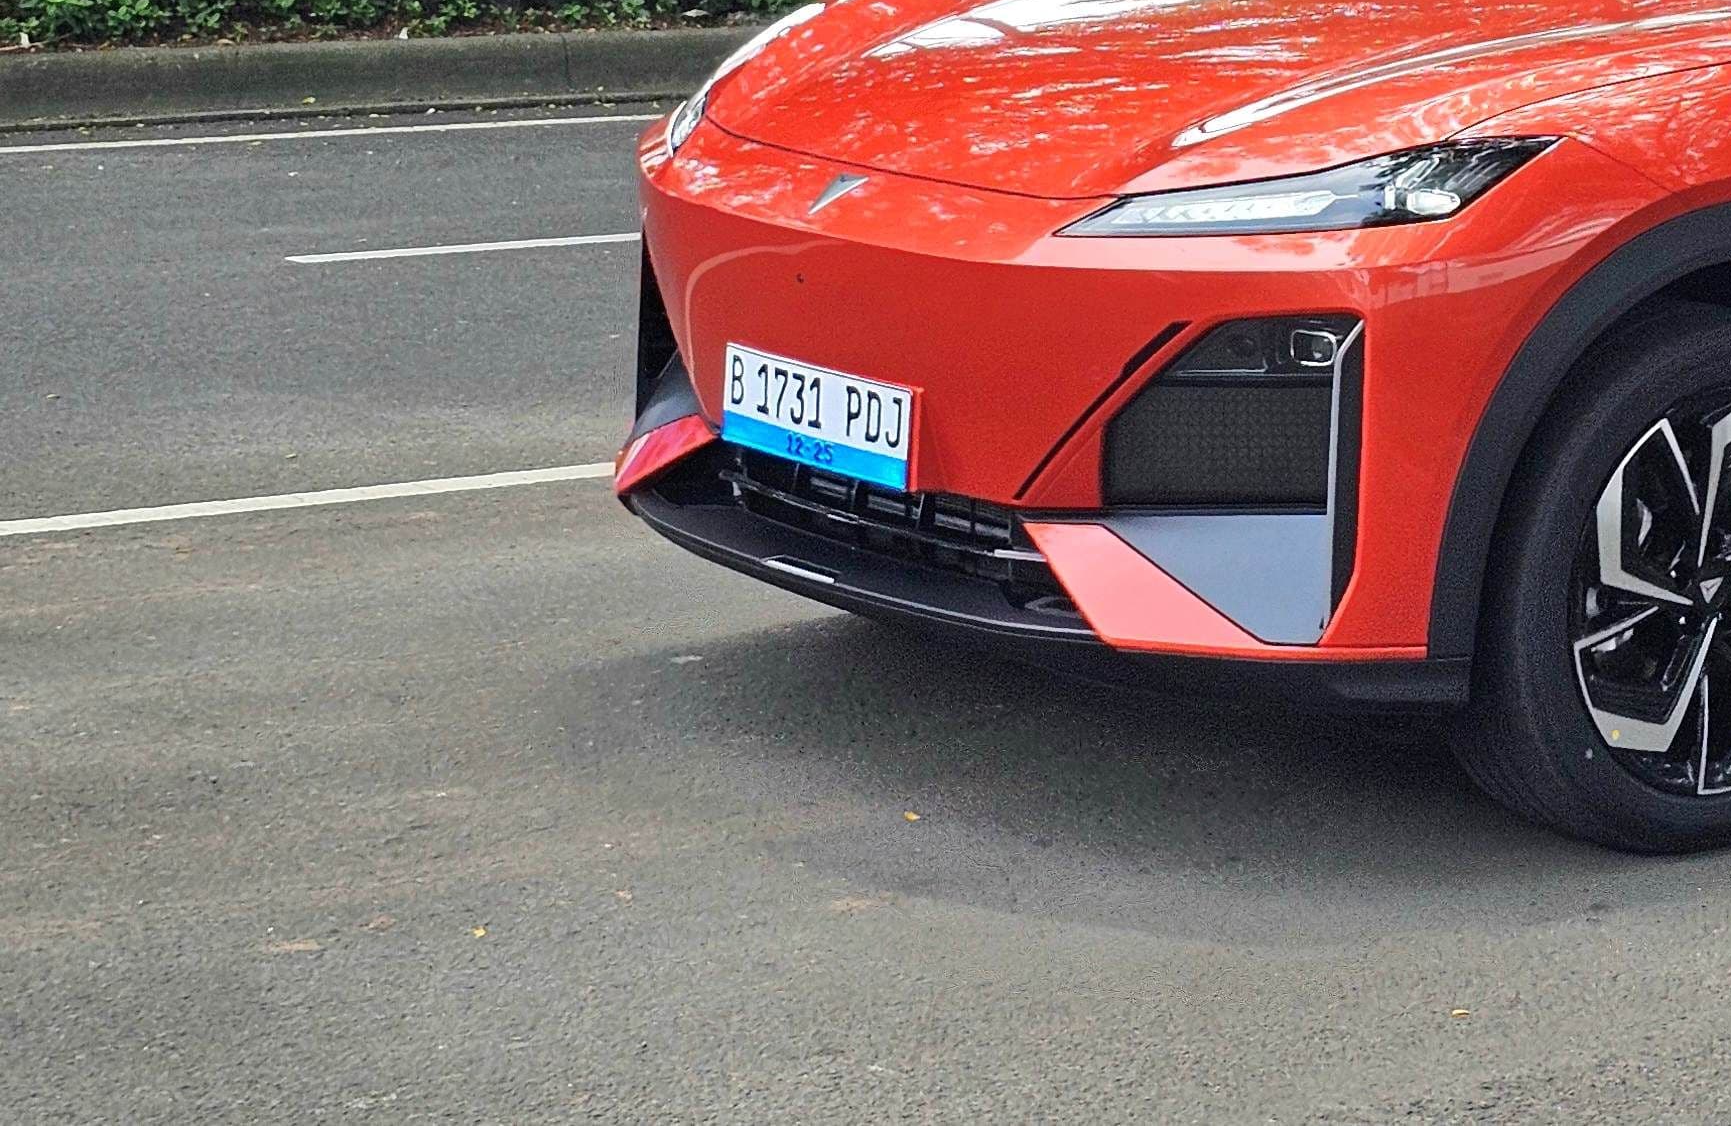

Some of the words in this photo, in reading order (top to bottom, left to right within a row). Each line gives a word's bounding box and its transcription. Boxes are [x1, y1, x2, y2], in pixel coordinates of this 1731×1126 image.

[731, 354, 745, 405] B
[757, 363, 822, 429] 1731
[845, 385, 903, 449] PDJ
